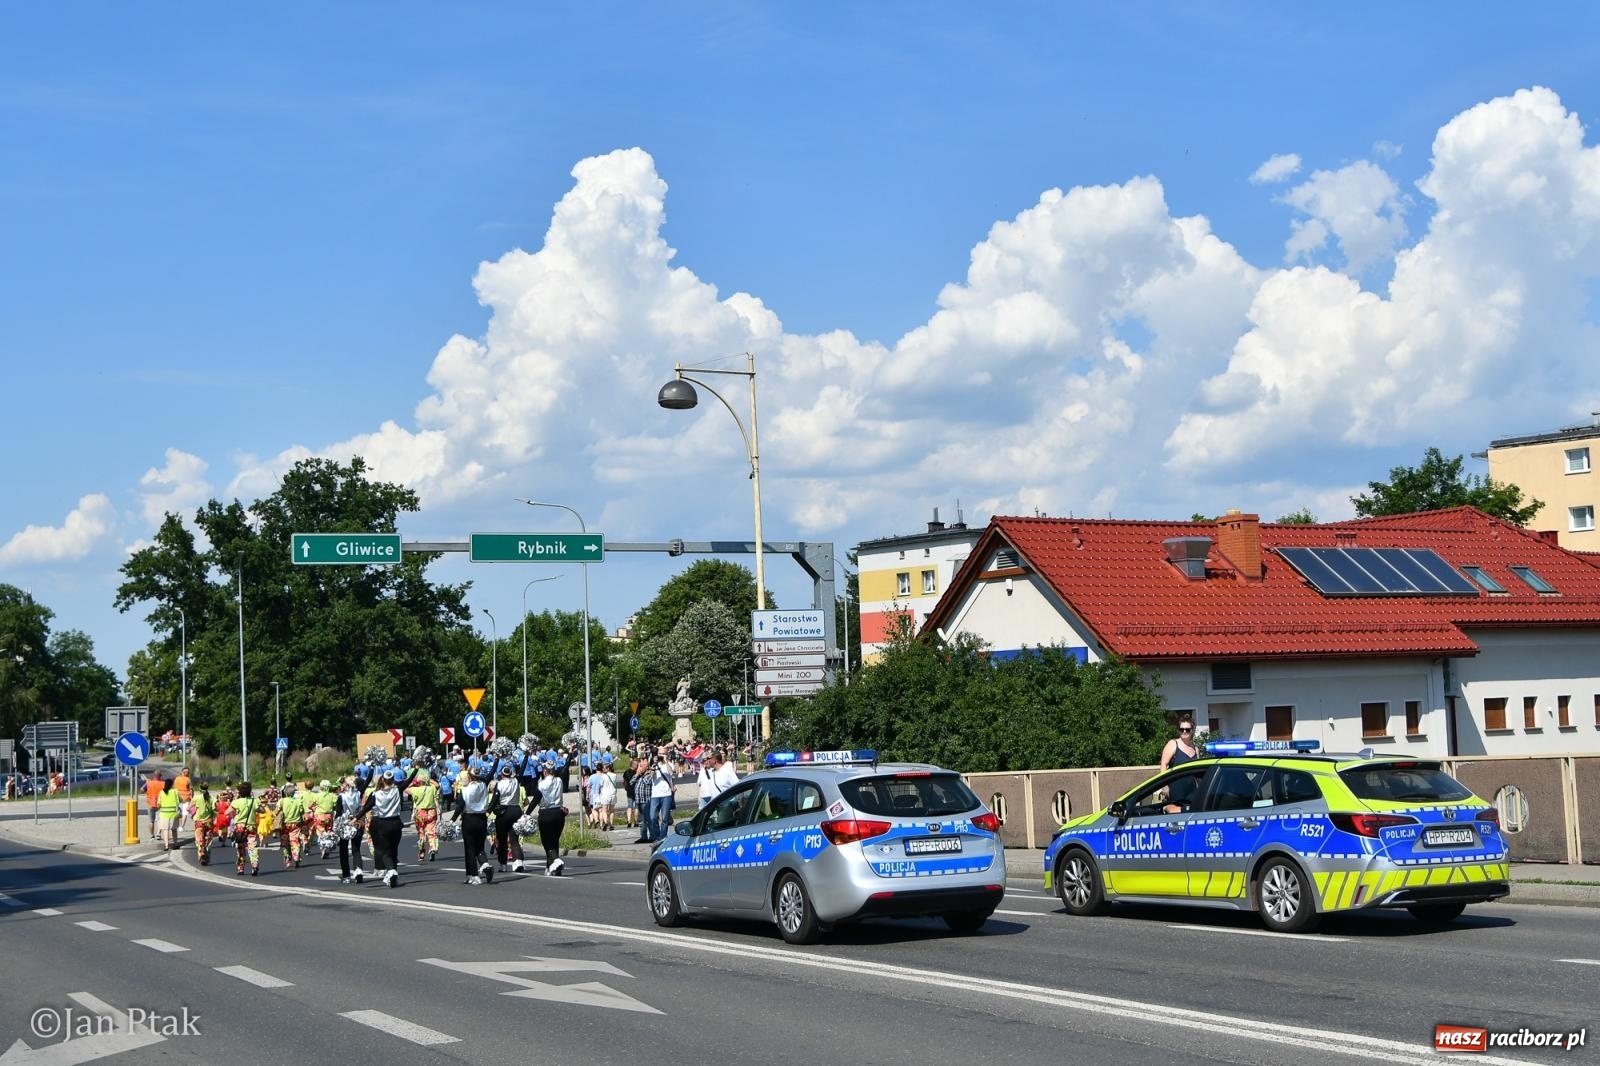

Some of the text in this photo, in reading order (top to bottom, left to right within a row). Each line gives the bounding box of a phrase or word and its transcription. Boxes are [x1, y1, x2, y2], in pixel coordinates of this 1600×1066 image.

[335, 541, 394, 556] Gliwice
[518, 541, 567, 558] Rybnik
[773, 614, 818, 623] Starostwo
[773, 626, 821, 636] Powiatowe
[796, 671, 812, 679] ZOO
[738, 707, 757, 715] Rybnik
[816, 751, 850, 762] POLICJA
[1301, 823, 1325, 838] R521
[1385, 829, 1416, 840] POLICJA
[805, 834, 822, 849] P113
[1114, 831, 1162, 851] POLICJA
[692, 849, 718, 864] POLICJA
[879, 861, 916, 873] POLICJA
